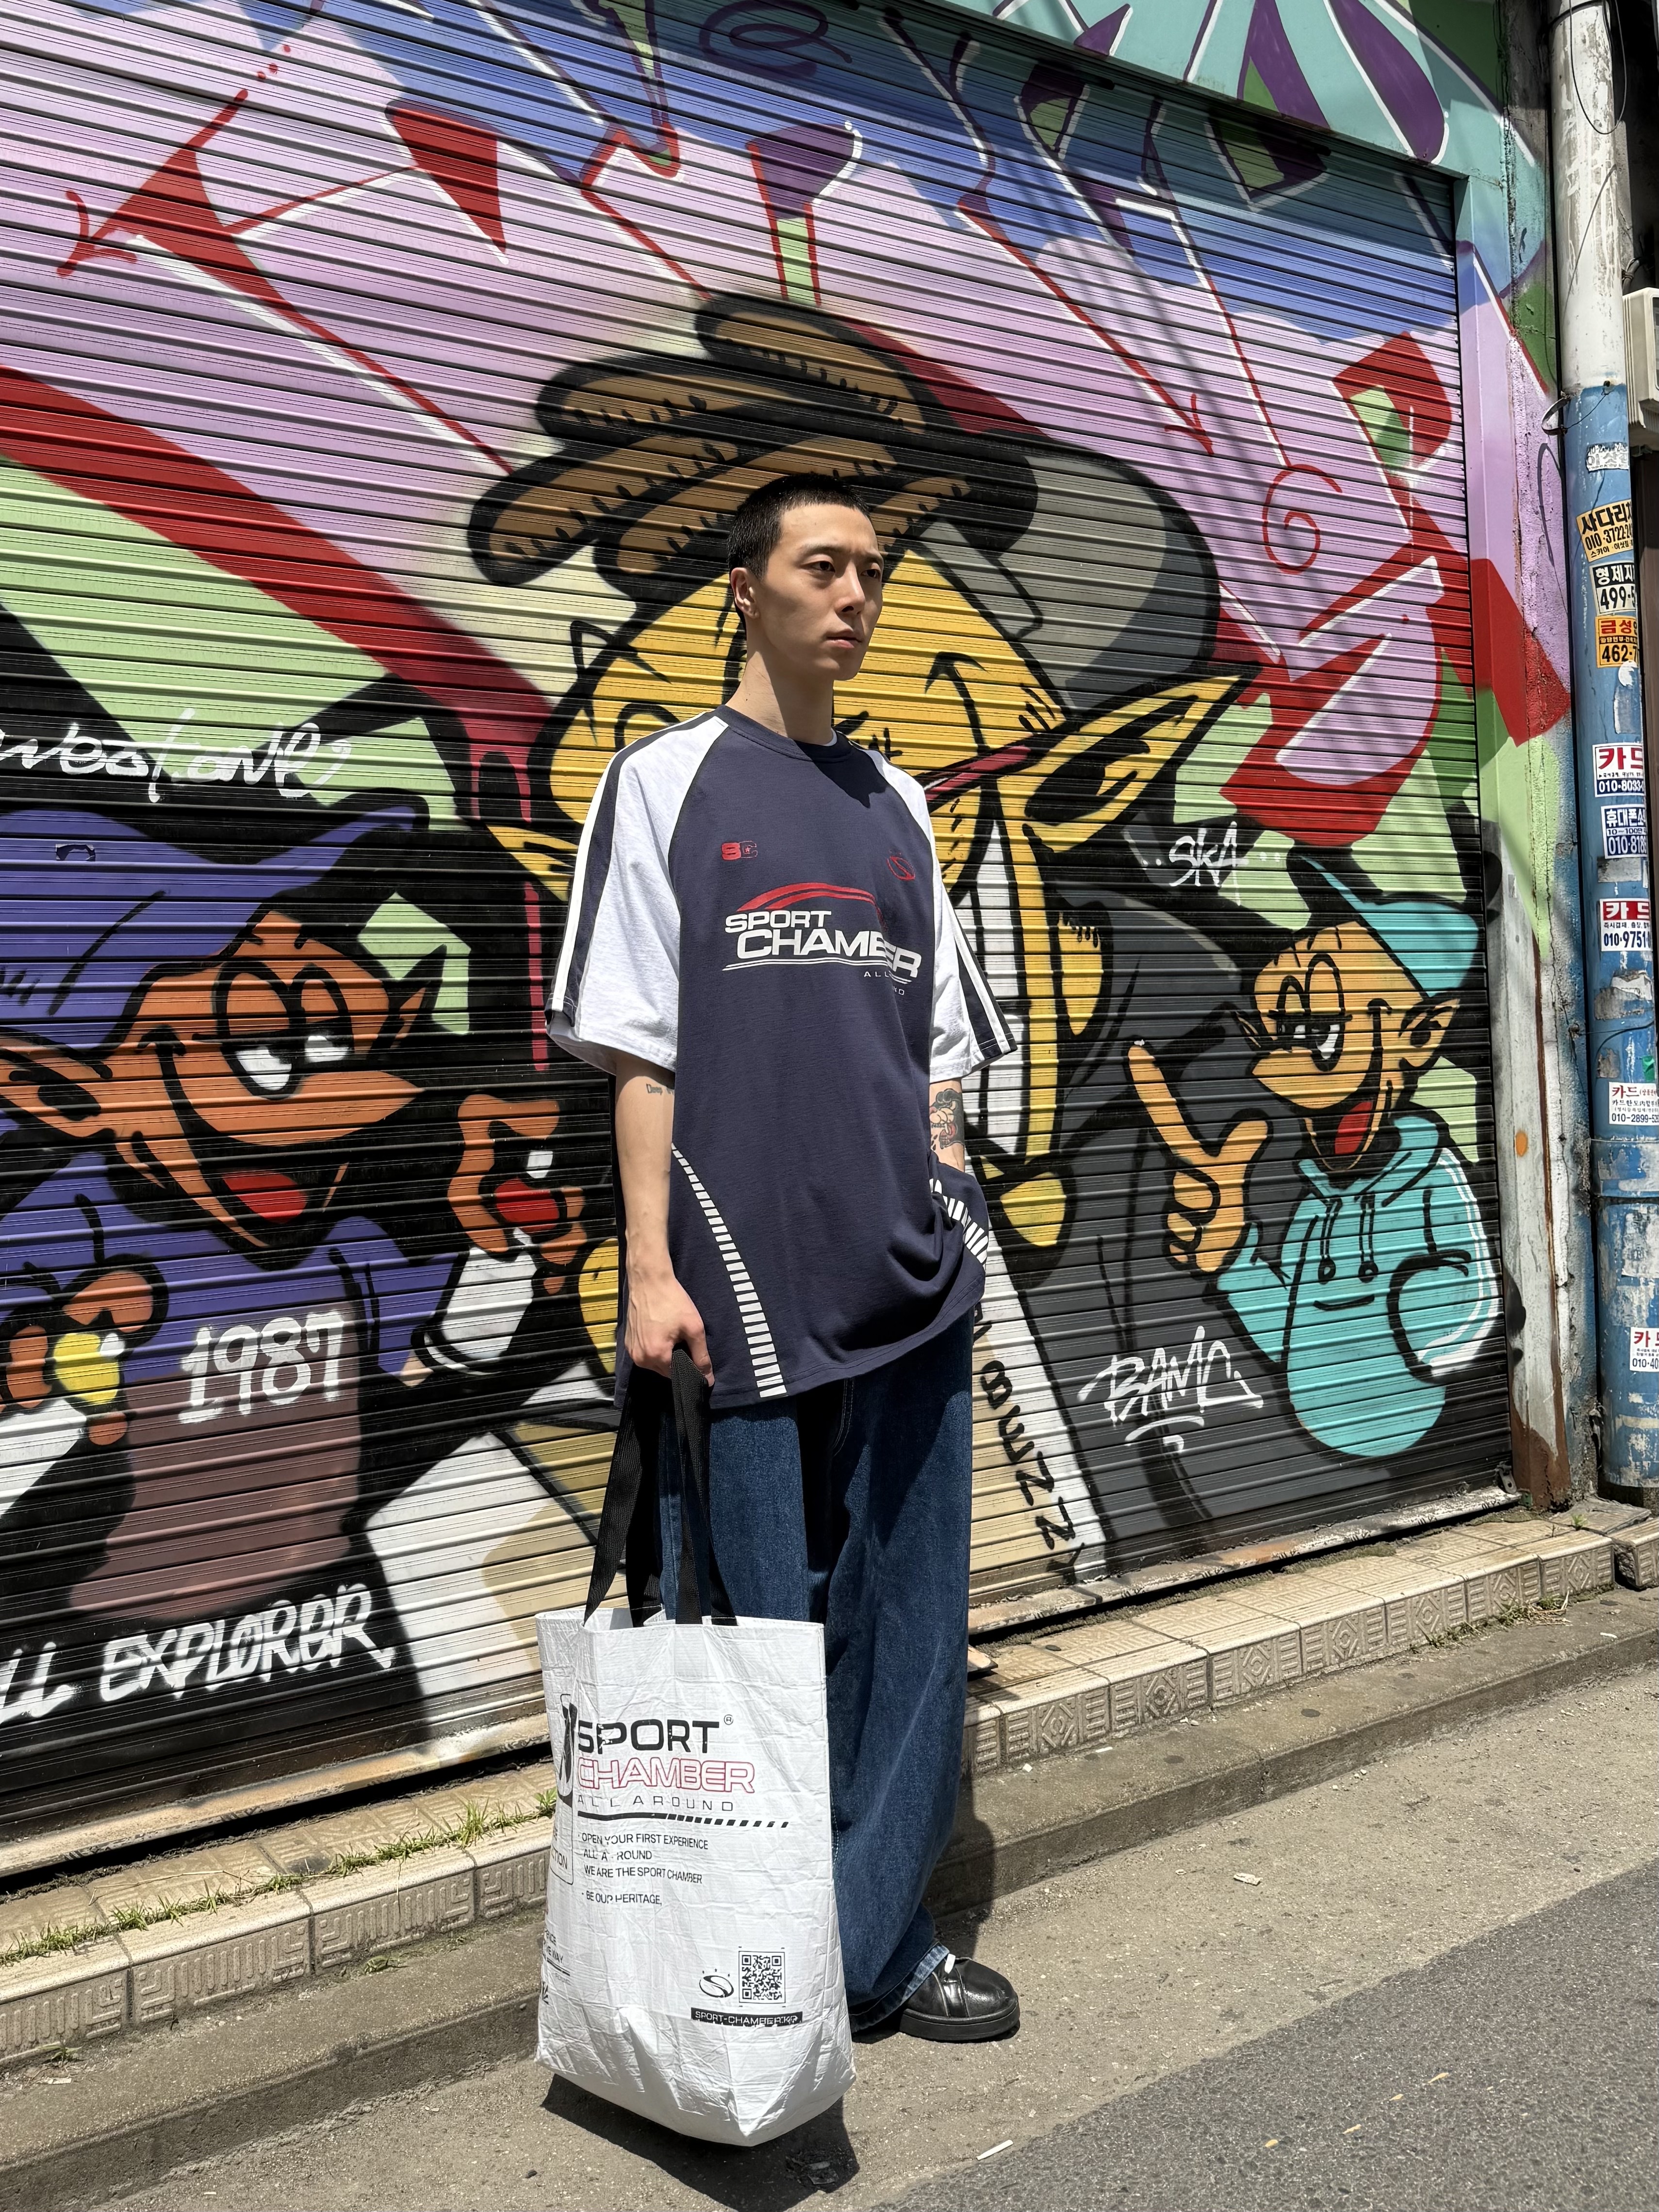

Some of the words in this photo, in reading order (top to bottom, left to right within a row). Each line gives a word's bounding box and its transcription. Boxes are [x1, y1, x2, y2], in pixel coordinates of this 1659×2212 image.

[725, 910, 831, 933] SPORT
[1612, 1085, 1640, 1099] 카드
[179, 1310, 343, 1424] 1987
[577, 1757, 755, 1793] CHAMBER
[577, 1795, 621, 1808] ALL
[633, 1795, 733, 1811] AROUND
[582, 1833, 602, 1844] OPEN
[636, 1834, 661, 1844] FIRST
[664, 1835, 708, 1850] EXPERIENCE
[584, 1849, 597, 1859] ALL
[584, 1864, 595, 1876] WE
[596, 1868, 613, 1878] ARE
[615, 1867, 636, 1878] THE
[637, 1868, 666, 1879] SPORT
[667, 1869, 702, 1884] CHAMBER
[586, 1891, 594, 1901] BE
